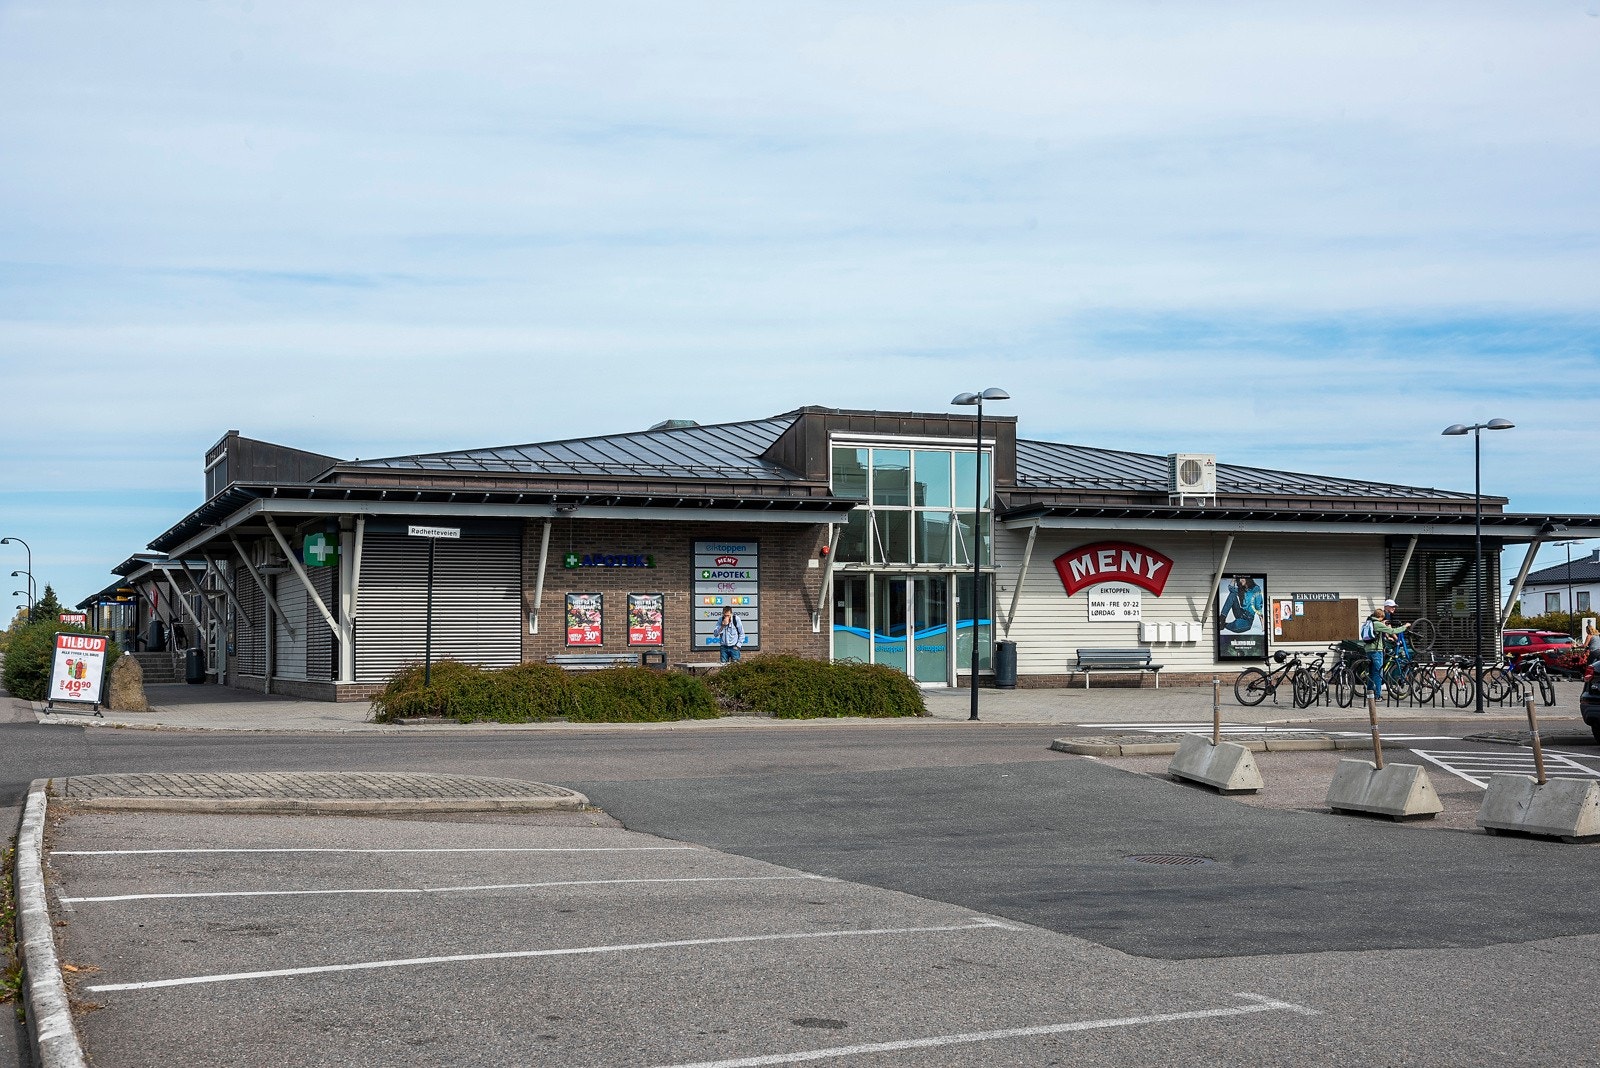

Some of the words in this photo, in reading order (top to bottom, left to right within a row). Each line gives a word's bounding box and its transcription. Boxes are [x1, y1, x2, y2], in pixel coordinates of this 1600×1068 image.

[706, 544, 746, 552] eiktoppen
[582, 554, 644, 568] APOTEK
[1068, 550, 1164, 582] MENY
[62, 636, 102, 650] TILBUD
